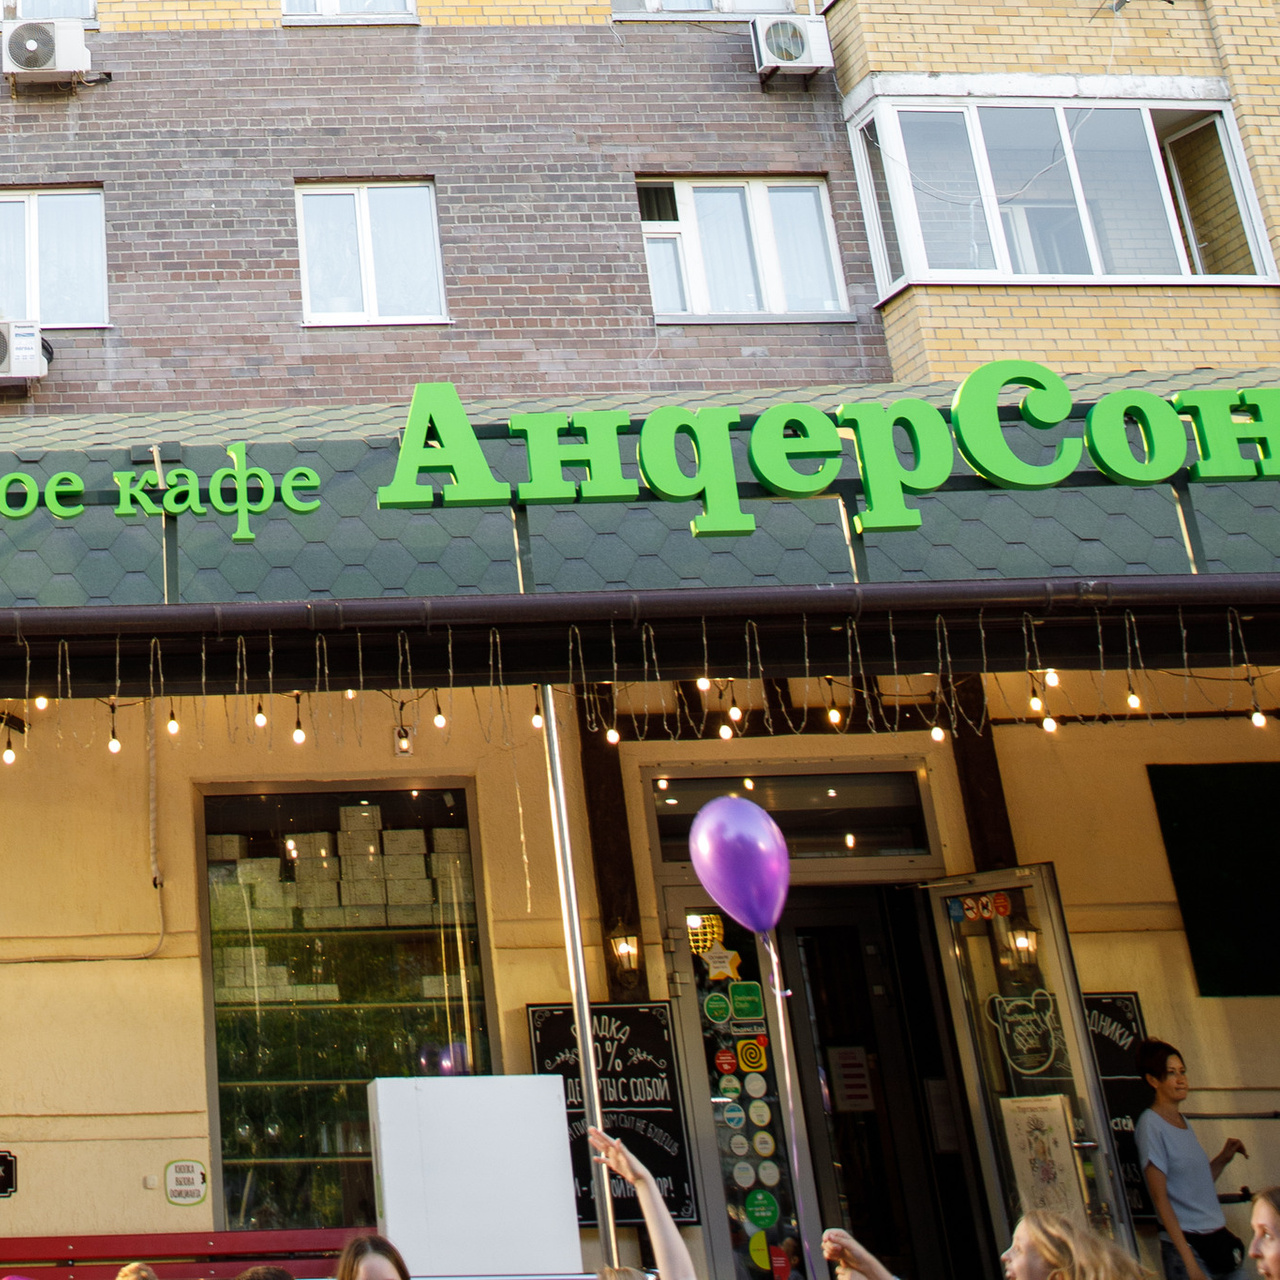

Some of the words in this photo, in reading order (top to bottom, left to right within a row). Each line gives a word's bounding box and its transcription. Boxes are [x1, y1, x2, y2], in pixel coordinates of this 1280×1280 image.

[113, 441, 322, 543] кафе
[618, 1077, 628, 1102] С
[630, 1072, 671, 1102] СОБОЙ
